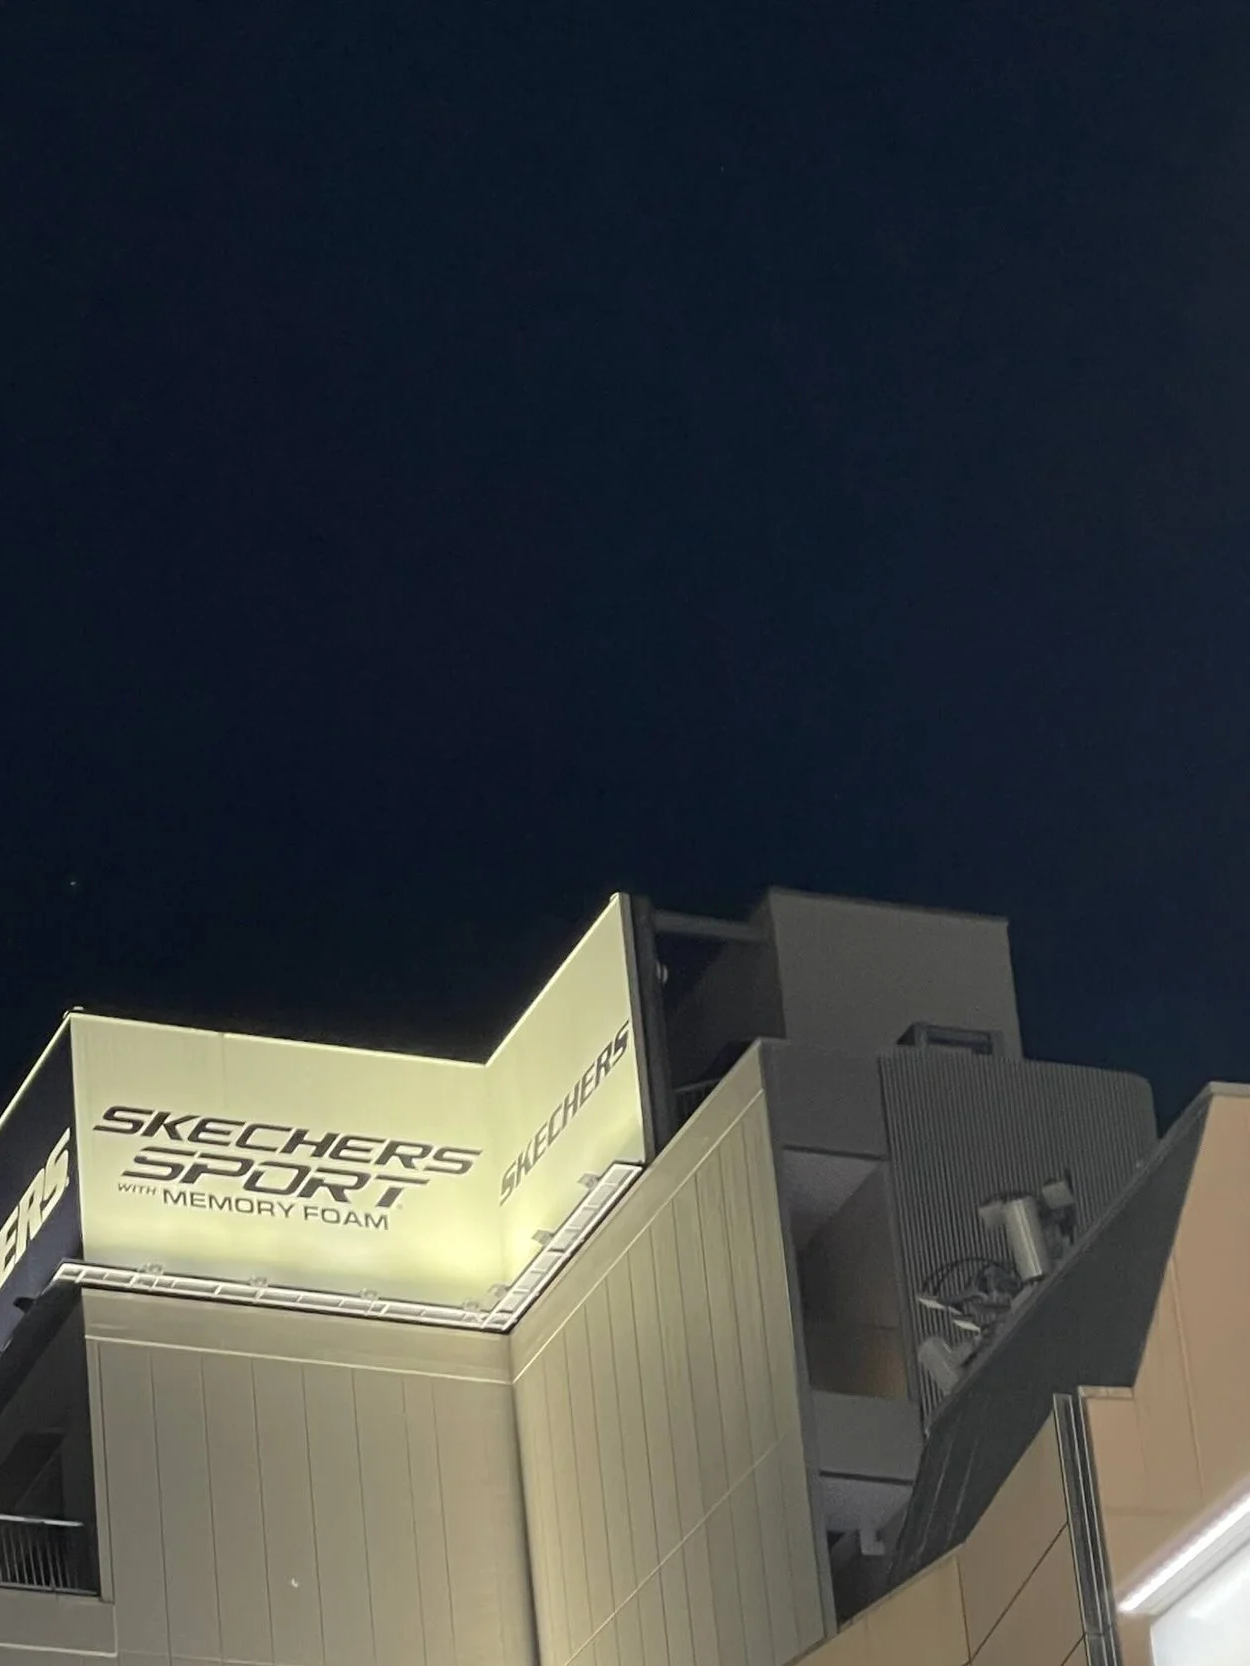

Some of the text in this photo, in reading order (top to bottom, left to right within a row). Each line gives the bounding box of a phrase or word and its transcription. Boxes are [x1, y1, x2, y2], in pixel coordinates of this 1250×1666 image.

[93, 1105, 482, 1175] SKECHERS
[500, 1019, 630, 1206] SKECHERS
[117, 1182, 390, 1231] WITH MEMORY FOAM
[121, 1147, 430, 1208] SPORT
